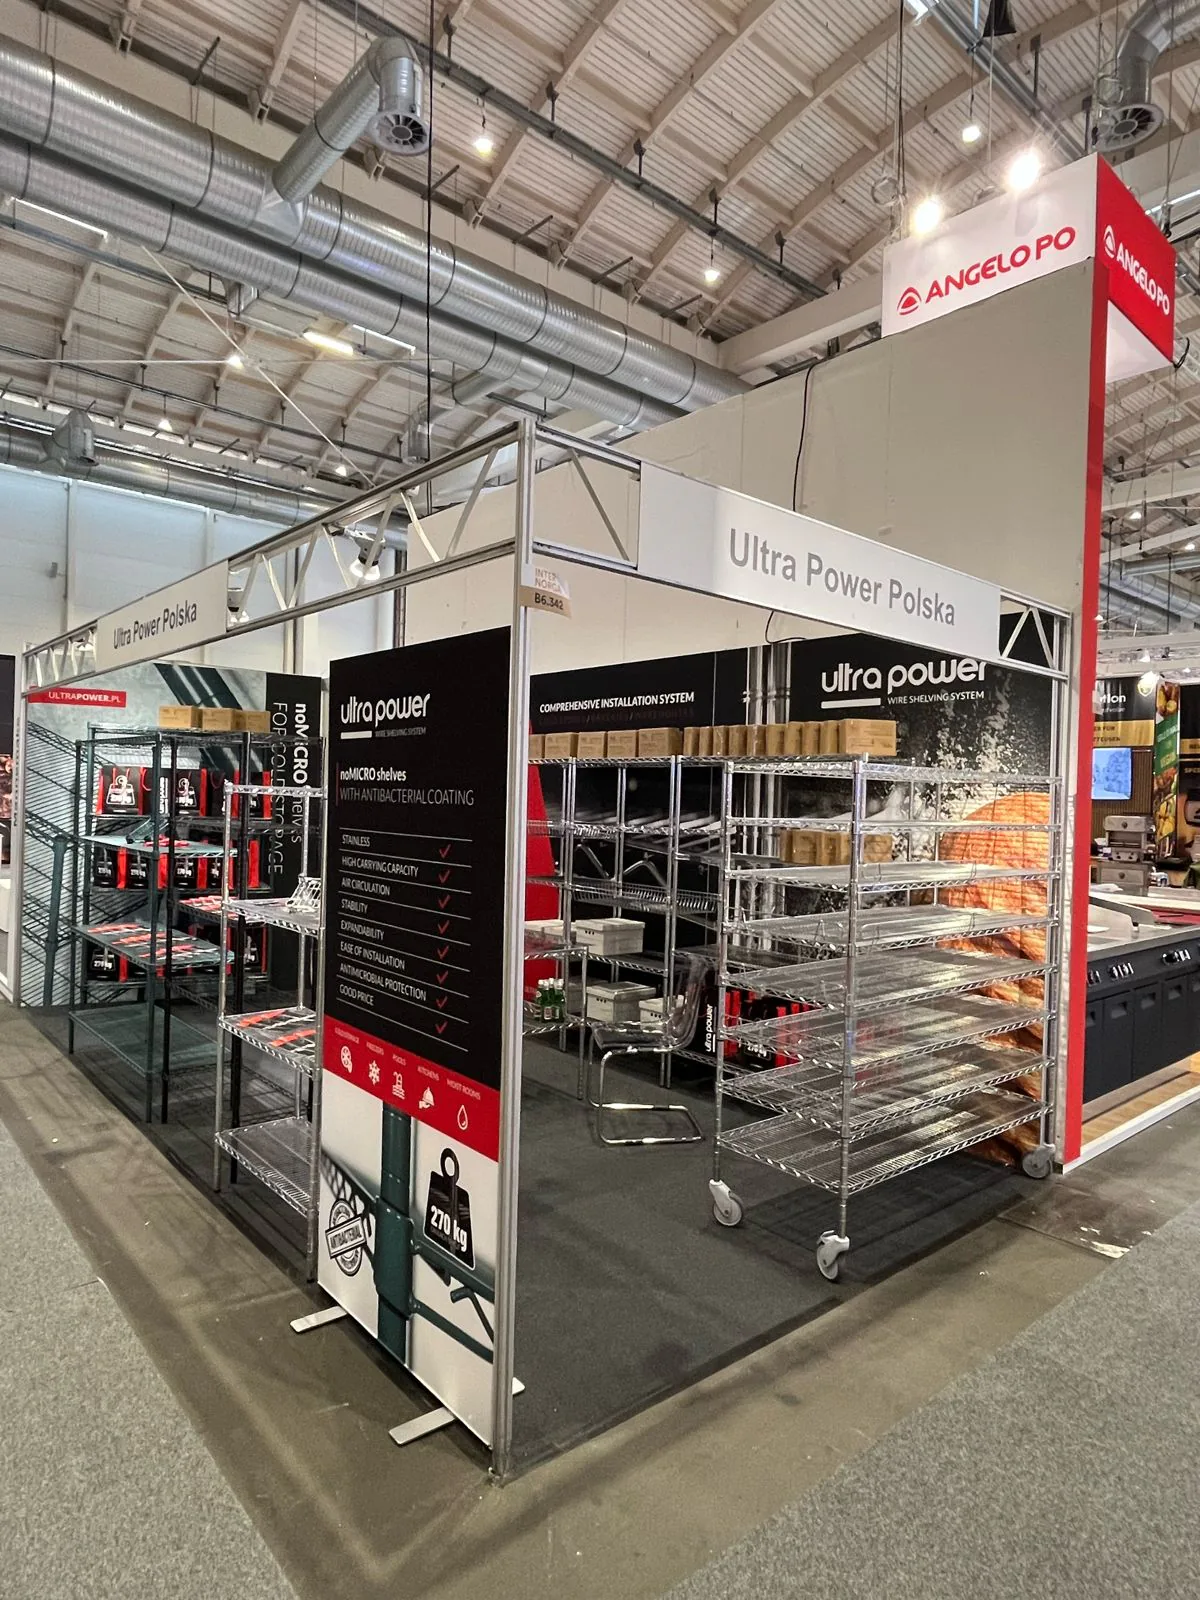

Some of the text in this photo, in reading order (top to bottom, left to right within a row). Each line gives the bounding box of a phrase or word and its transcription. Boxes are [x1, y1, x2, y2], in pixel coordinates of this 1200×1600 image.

[925, 226, 1076, 304] ANGELO PO
[1116, 242, 1170, 316] ANGELO PO
[730, 528, 955, 626] Ultra Power Polska
[534, 592, 564, 610] B6.342
[113, 600, 197, 649] Ultra Power Polska
[821, 657, 987, 695] ultra power
[48, 690, 122, 704] ULTRAPOWER.PL
[539, 691, 695, 714] COMPREHENSIVE INSTALLATION SYSTEM
[887, 690, 985, 705] WIRE SHELVING SYSTEM
[340, 693, 431, 728] ultra power
[340, 766, 407, 782] noMICRO shelves
[339, 787, 475, 806] WITH ANTIBACTERIAL COATING
[342, 834, 371, 848] STAINLESS
[342, 856, 419, 878] HIGH CARRYING CAPACITY
[341, 878, 391, 896] AIR CIRCULATION
[341, 899, 368, 914] STABILITY
[340, 919, 385, 941] EXPANDABILITY
[340, 940, 406, 970] EASE OF INSTALLATION
[339, 962, 427, 1002] ANTIMICROBIAL PROTECTION
[339, 983, 375, 1007] GOOD PRICE
[705, 1003, 713, 1033] power
[430, 1204, 451, 1236] 270
[453, 1219, 468, 1253] kg
